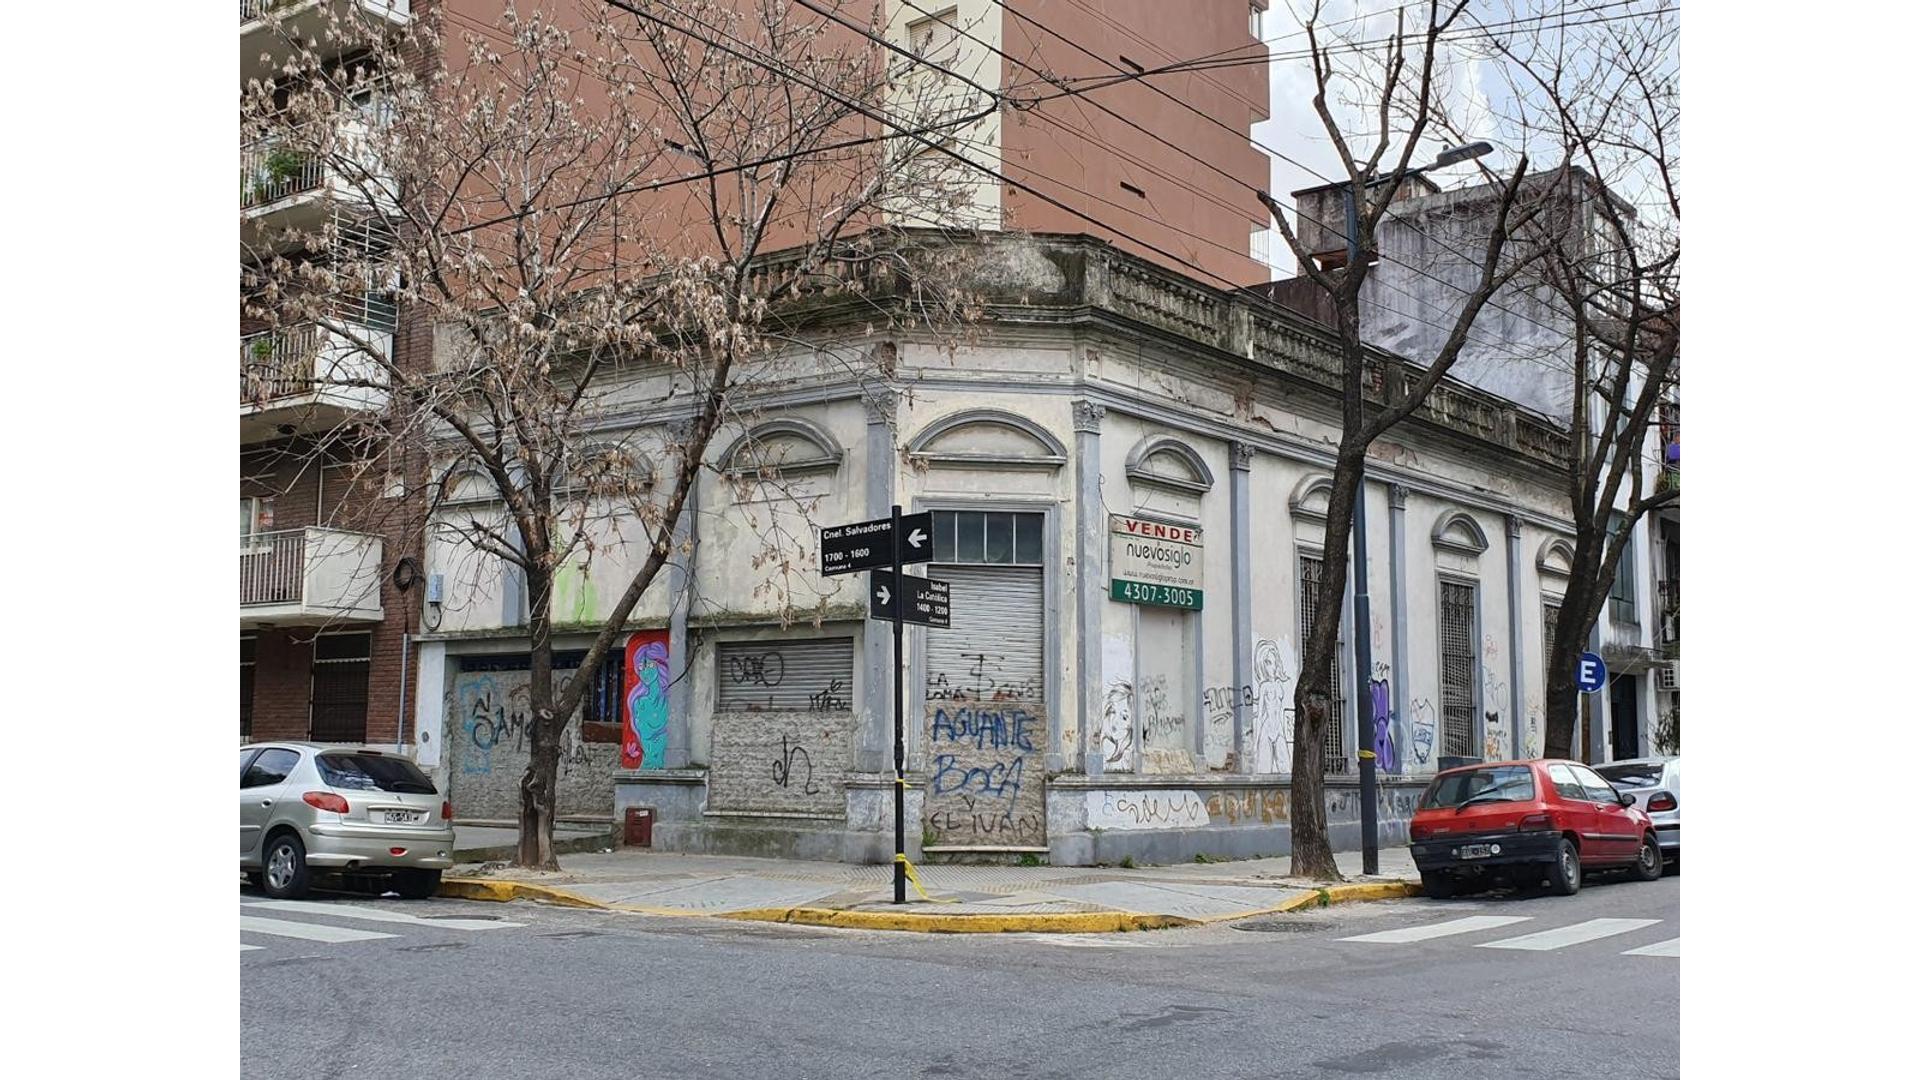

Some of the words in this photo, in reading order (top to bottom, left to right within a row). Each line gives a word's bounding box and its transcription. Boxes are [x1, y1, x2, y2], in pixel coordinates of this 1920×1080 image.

[823, 529, 843, 540] Cnel.
[845, 522, 892, 537] Salvadores
[1126, 519, 1192, 543] VENDE
[824, 552, 843, 562] 1700
[851, 547, 870, 559] 1600
[1126, 542, 1192, 568] nuevosiglo
[916, 589, 924, 599] La
[930, 581, 948, 593] Isabel
[1124, 583, 1193, 605] 4307-3005
[934, 605, 948, 615] 1200
[1580, 660, 1596, 683] E
[933, 706, 1036, 752] AGUANTE
[972, 813, 1039, 837] IVAN
